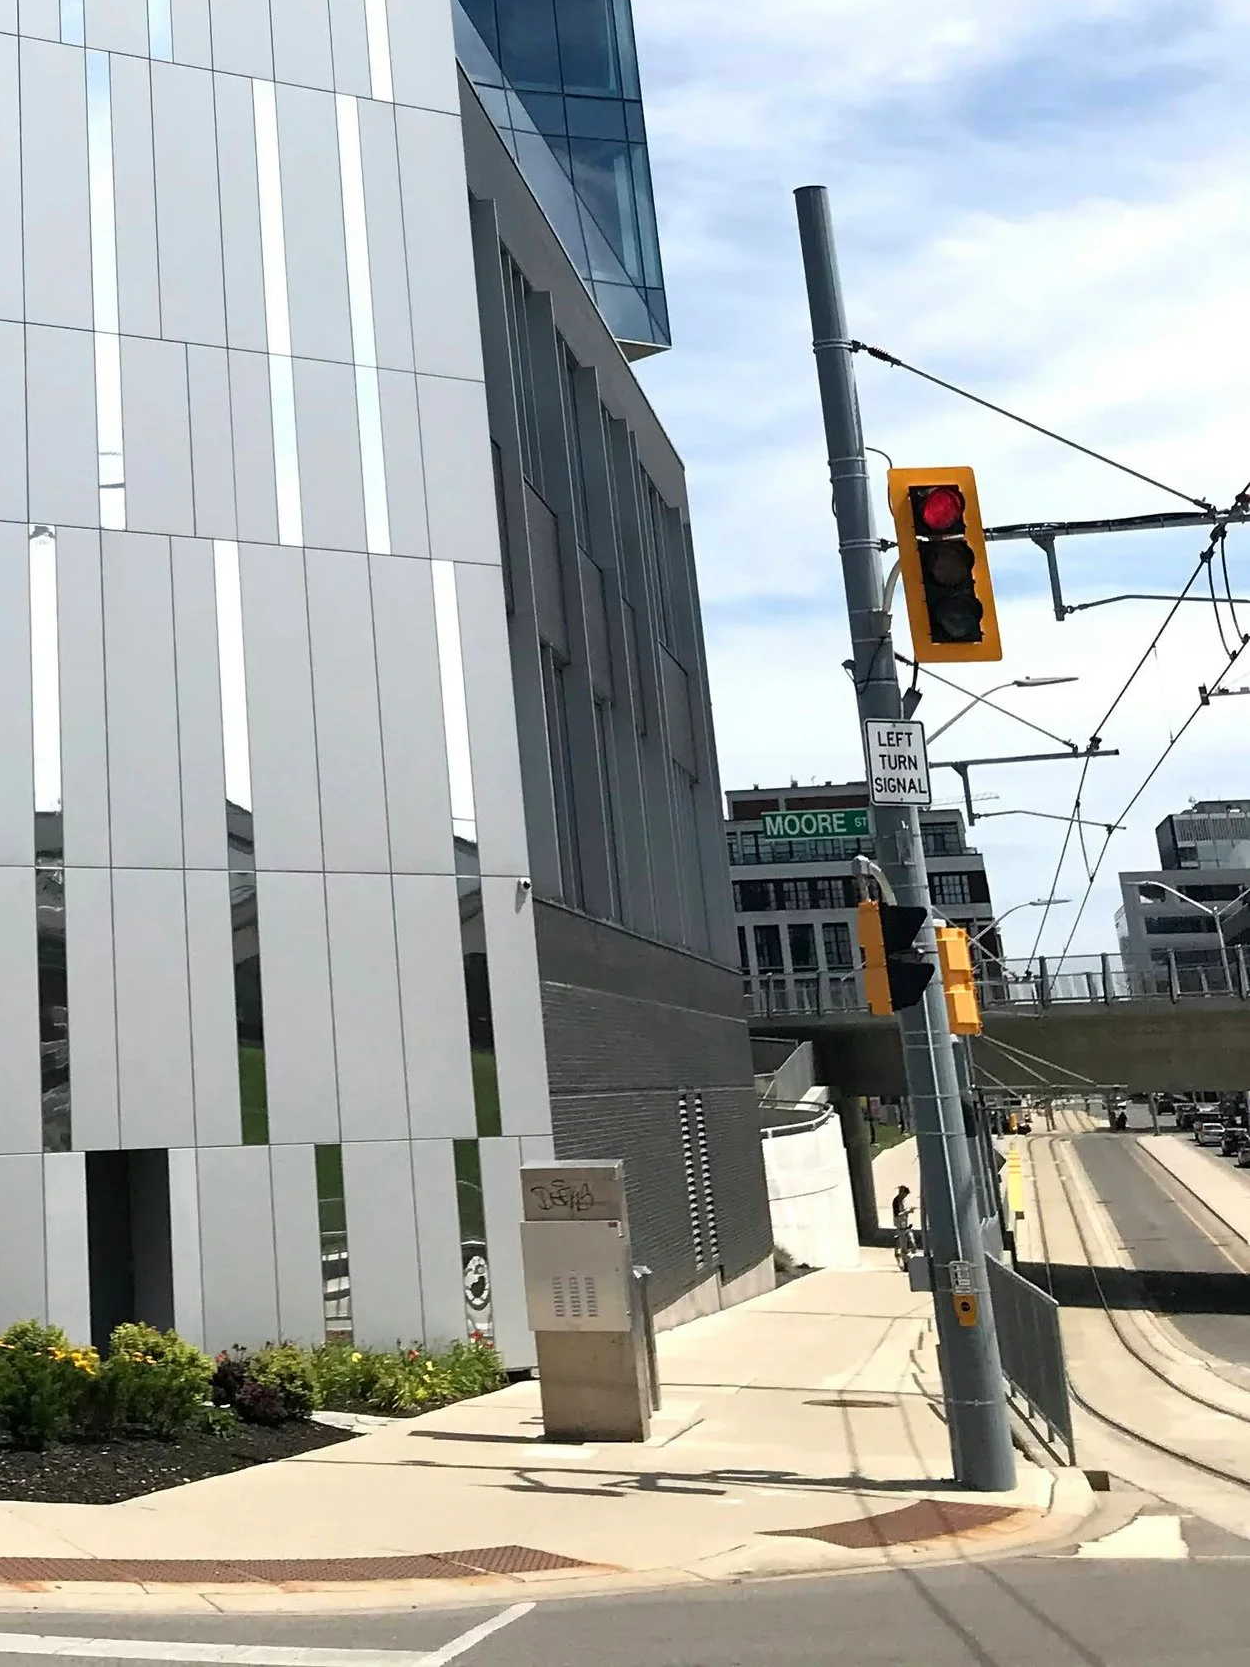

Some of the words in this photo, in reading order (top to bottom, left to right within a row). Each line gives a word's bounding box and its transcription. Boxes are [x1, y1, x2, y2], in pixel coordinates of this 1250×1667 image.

[877, 731, 913, 747] LEFT
[878, 754, 918, 771] TURN
[874, 777, 927, 794] SIGNAL
[765, 813, 847, 835] MOORE
[854, 816, 867, 828] ST
